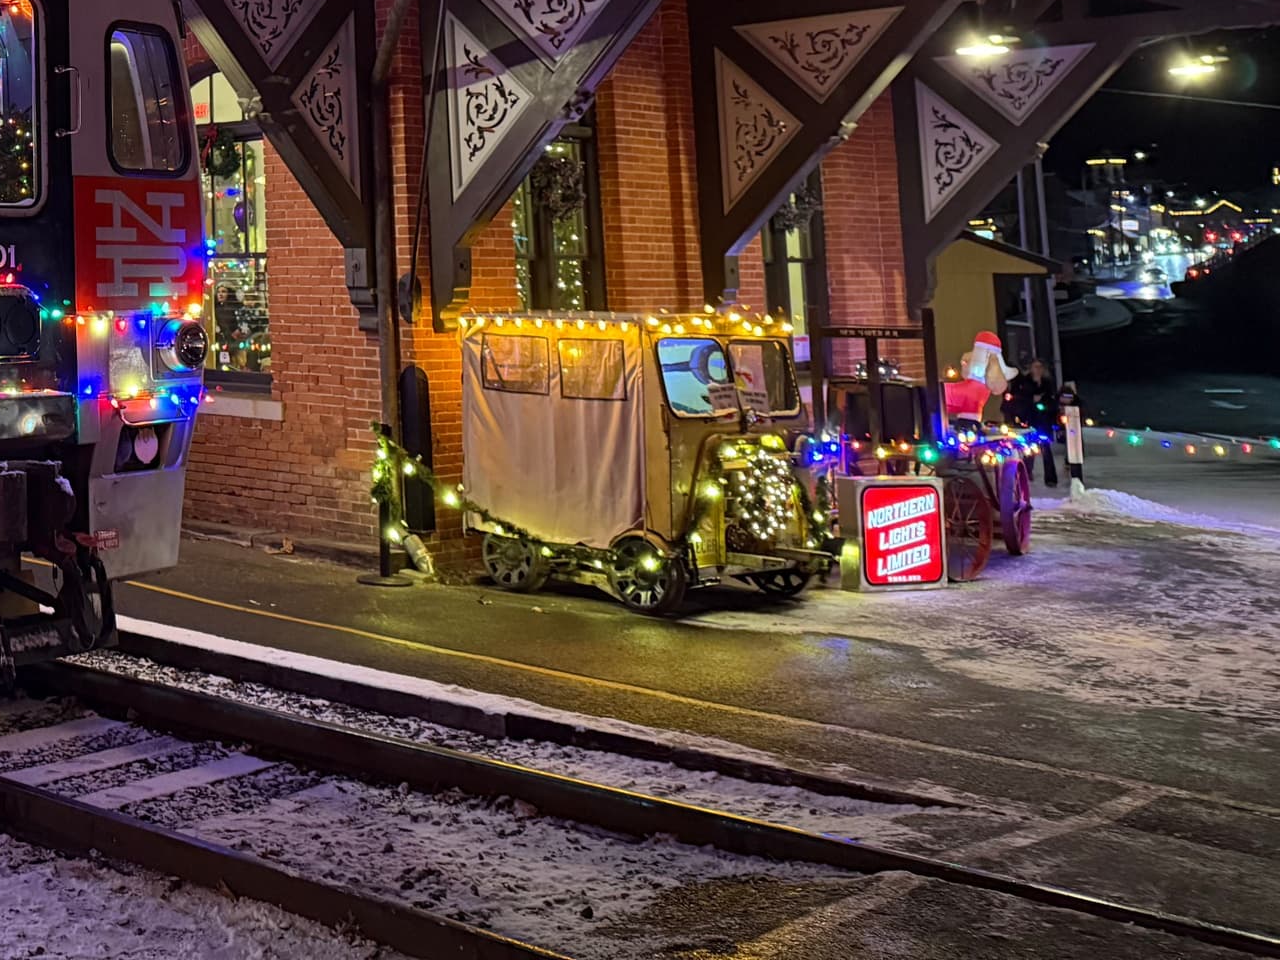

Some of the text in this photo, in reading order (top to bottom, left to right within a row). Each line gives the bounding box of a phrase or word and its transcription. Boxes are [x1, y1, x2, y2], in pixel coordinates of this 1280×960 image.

[867, 494, 935, 529] NORTHERN
[879, 521, 926, 551] LIGHTS
[877, 544, 931, 576] LIMITED
